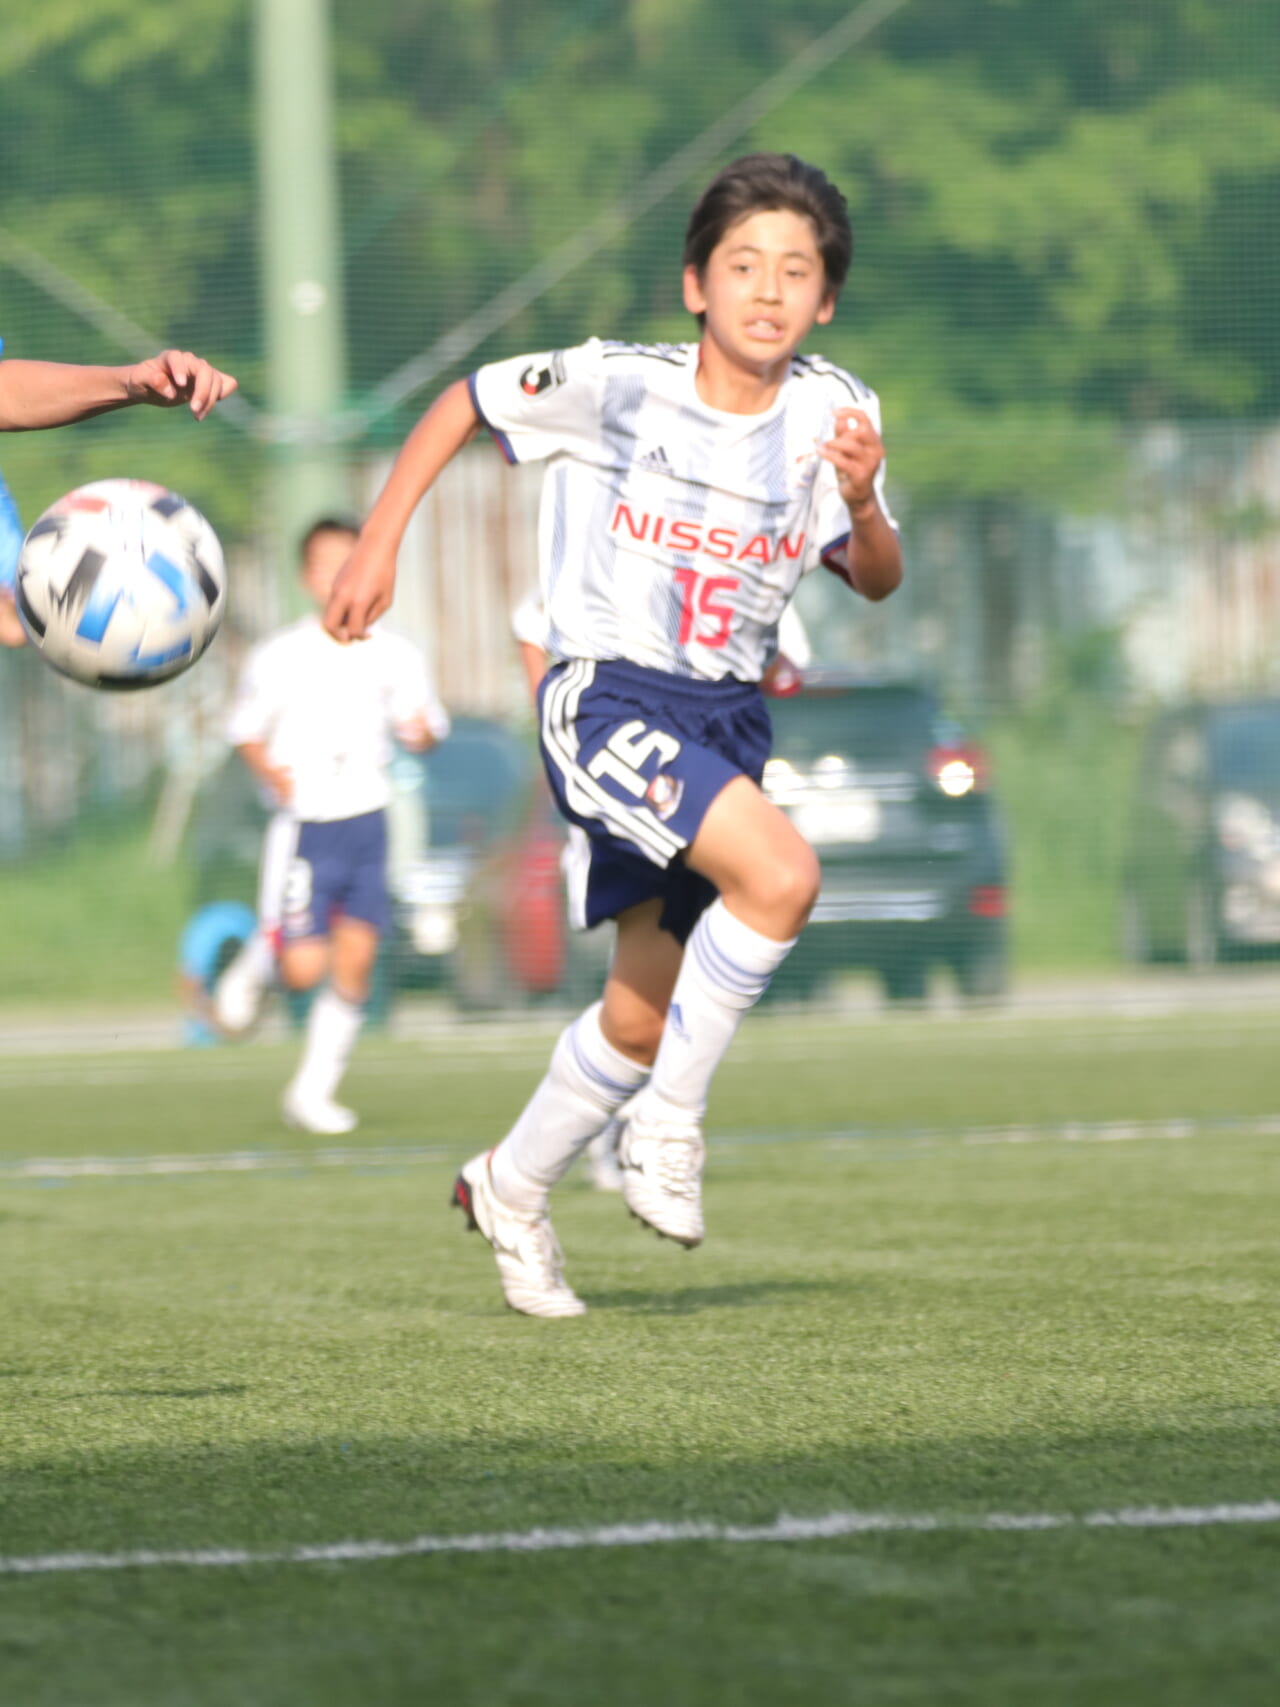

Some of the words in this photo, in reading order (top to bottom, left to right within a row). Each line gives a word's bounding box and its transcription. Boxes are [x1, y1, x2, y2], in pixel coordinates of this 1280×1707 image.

[611, 503, 806, 565] NISSAN
[673, 566, 741, 647] 15
[587, 719, 681, 799] 15
